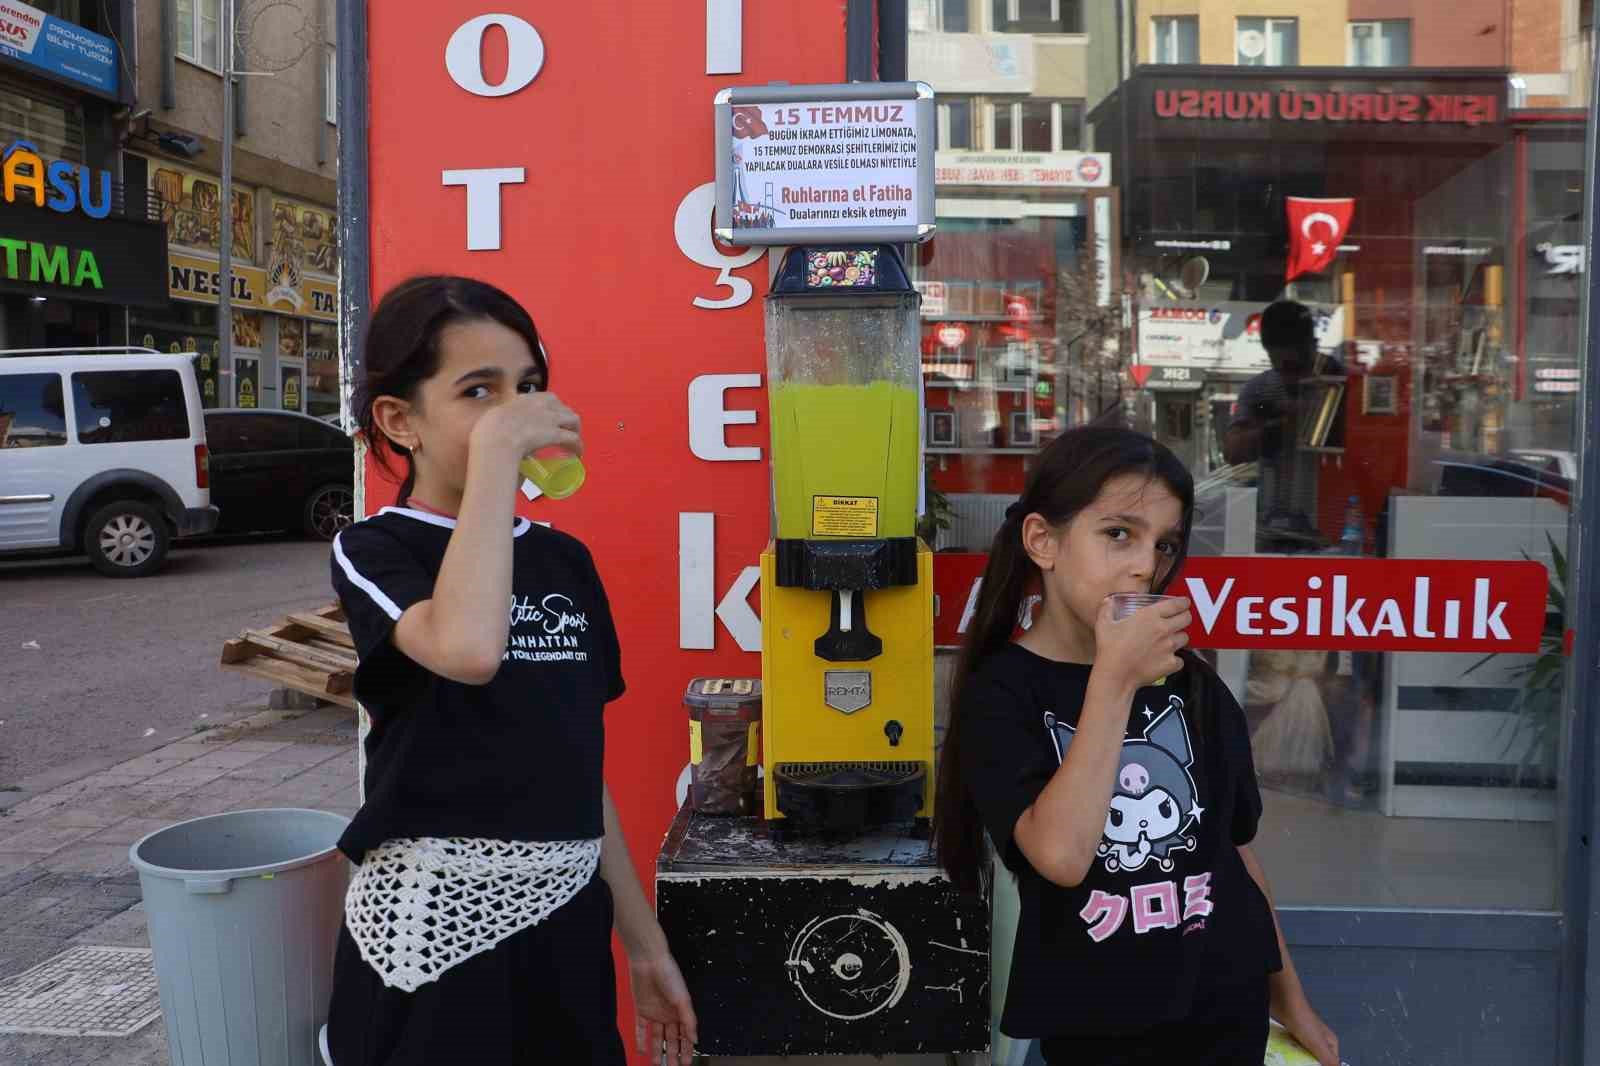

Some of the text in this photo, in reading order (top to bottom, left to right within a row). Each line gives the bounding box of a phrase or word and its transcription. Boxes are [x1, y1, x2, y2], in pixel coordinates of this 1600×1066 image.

[775, 105, 903, 125] 15 TEMMUZ
[769, 128, 799, 141] BUGÜN
[800, 128, 827, 140] İKRAM
[871, 126, 917, 139] LİMONATA,
[754, 142, 917, 157] 15 TEMMUZ DEMOKRASİ ŞEHİTLERİMİZ İÇİN
[745, 157, 917, 172] YAPILACAK DUALARA VESİLE OLMASI NİYETİYLE
[781, 184, 913, 205] Ruhlarına el Fatiha
[789, 206, 907, 220] Dualarınızı eksik etmeyin
[0, 238, 104, 289] TMA
[312, 290, 337, 312] TA
[505, 635, 578, 648] ANHATTAN
[829, 686, 866, 696] REMTA
[1079, 872, 1214, 943] クロミ
